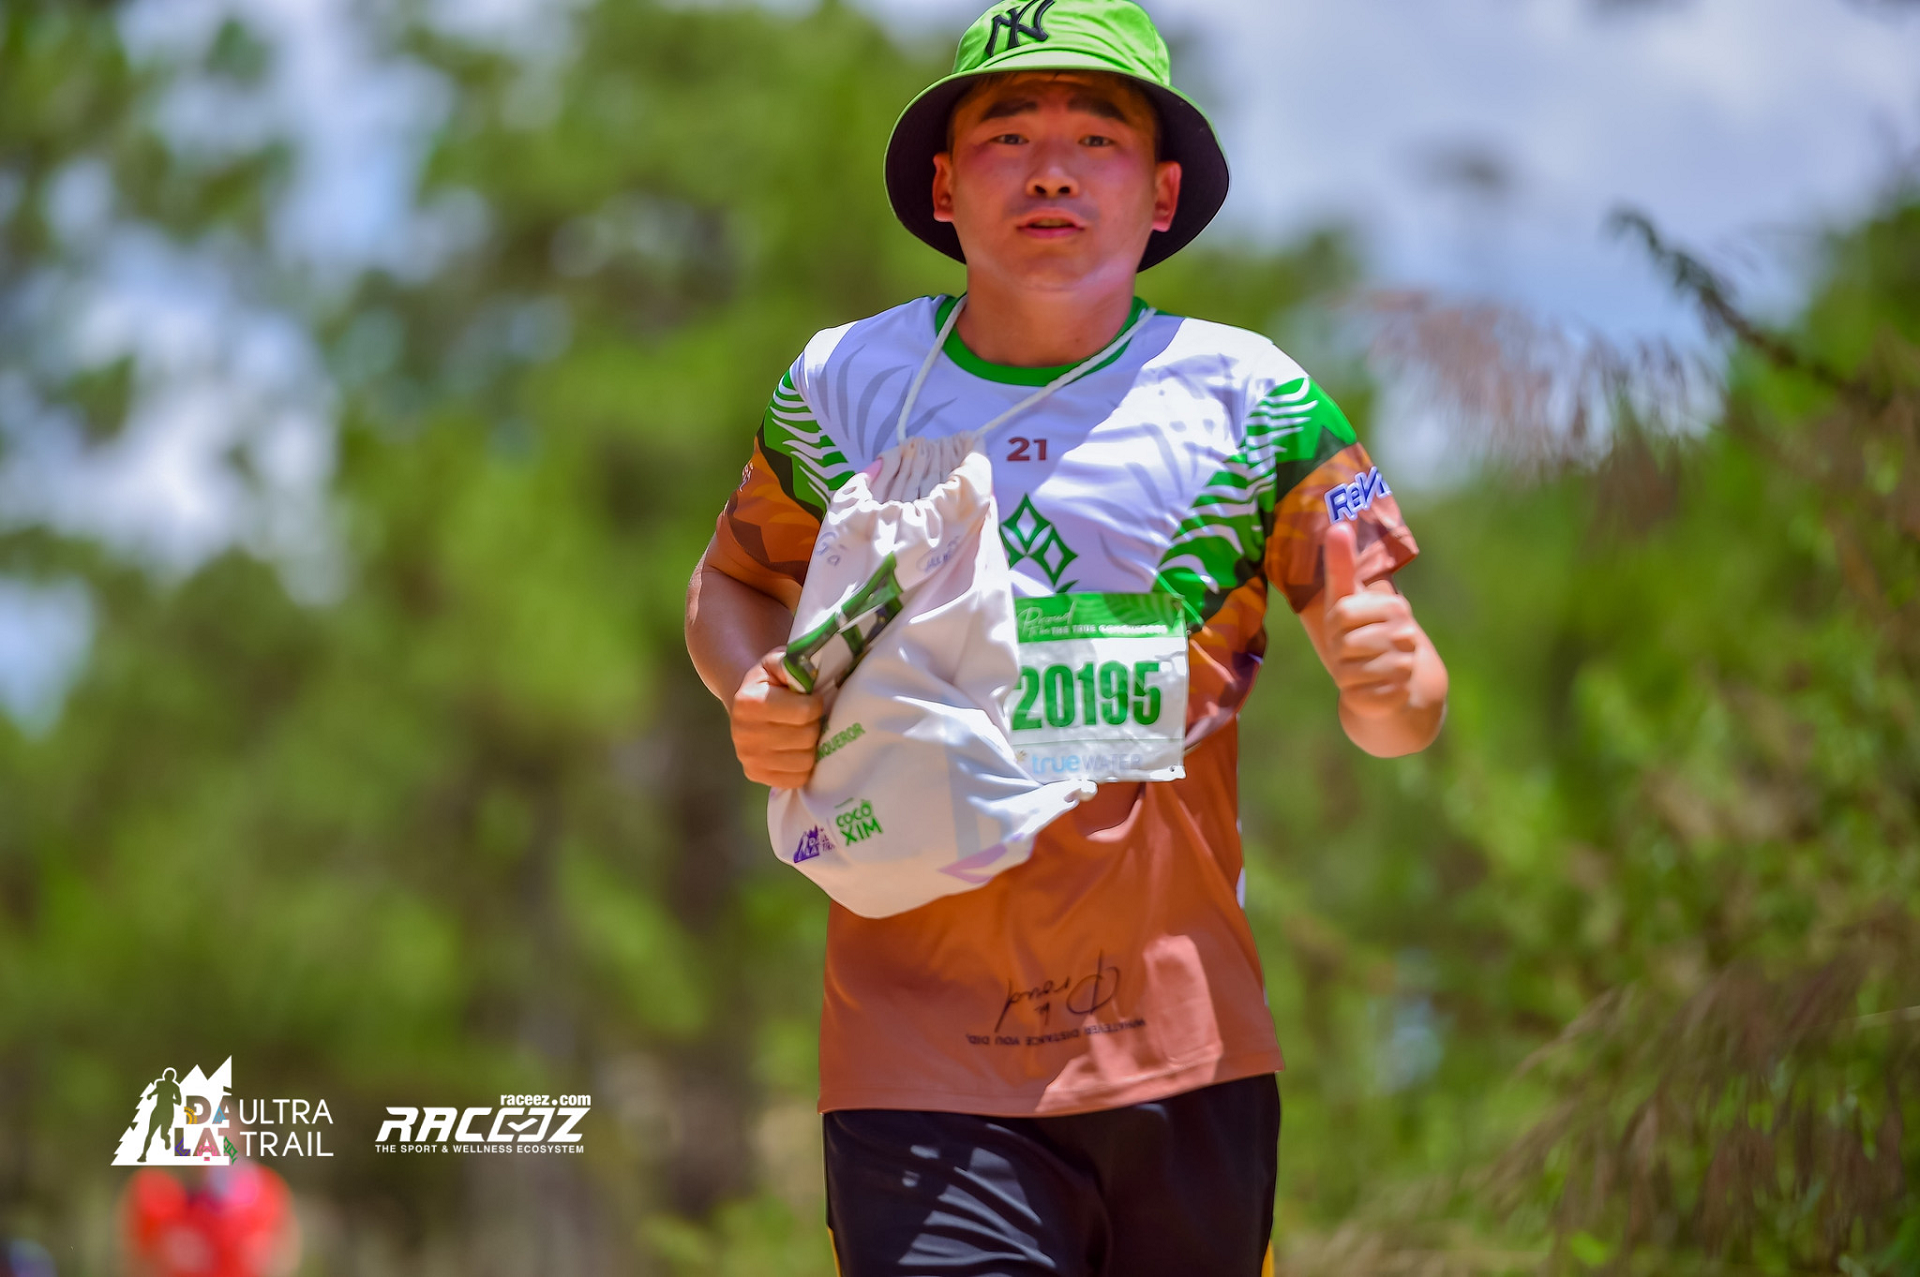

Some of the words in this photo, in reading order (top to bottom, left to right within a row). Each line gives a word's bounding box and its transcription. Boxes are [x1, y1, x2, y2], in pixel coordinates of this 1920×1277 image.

[1006, 436, 1048, 462] 21
[1012, 661, 1162, 731] 20195
[840, 817, 884, 847] XIM
[994, 950, 1121, 1034] Proud
[1024, 1028, 1080, 1046] DISTANCE
[1084, 1017, 1146, 1035] WHATEVER
[995, 1035, 1020, 1046] YOU
